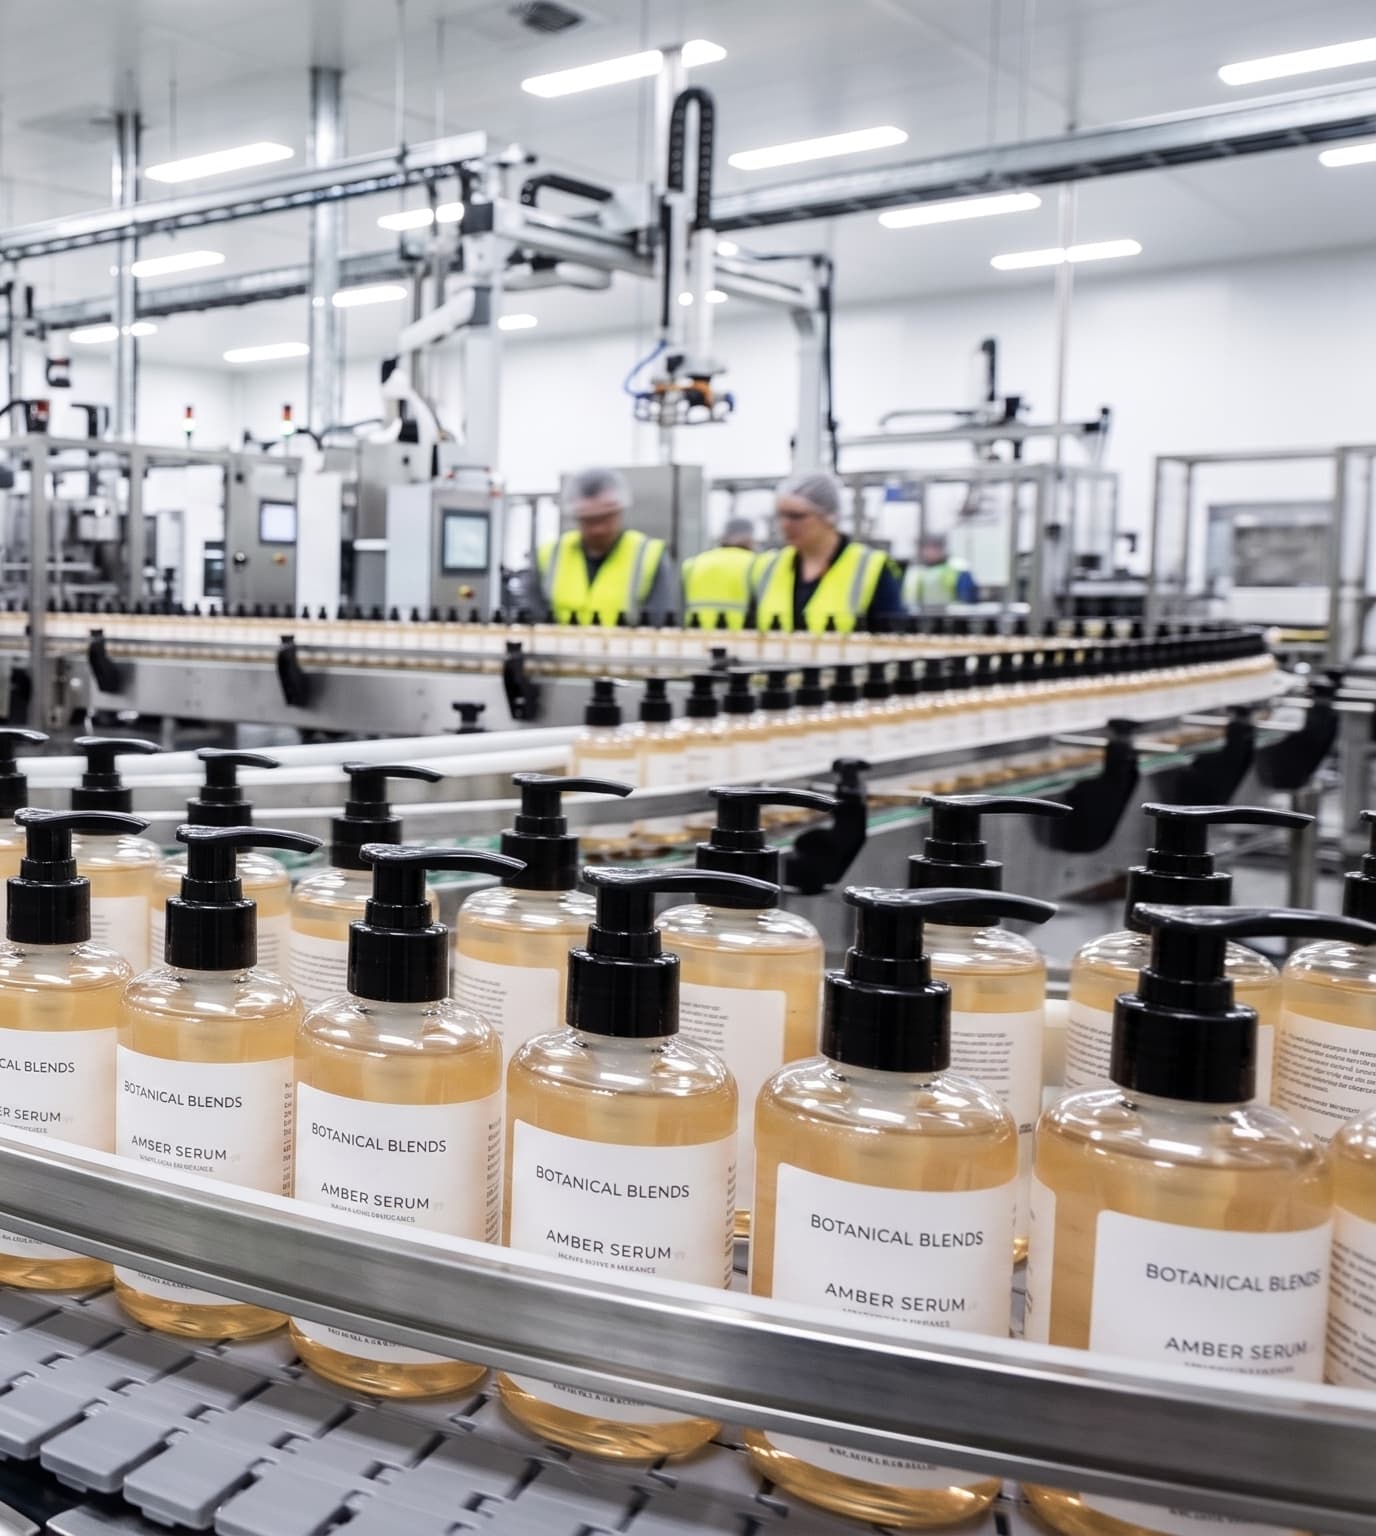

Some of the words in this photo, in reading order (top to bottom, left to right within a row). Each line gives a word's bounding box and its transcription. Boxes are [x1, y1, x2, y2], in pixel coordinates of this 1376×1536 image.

[24, 1061, 76, 1074] BLENDS
[124, 1080, 185, 1107] BOTANICAL
[188, 1095, 243, 1109] BLENDS
[14, 1108, 62, 1123] SERUM
[311, 1122, 384, 1151] BOTANICAL
[388, 1139, 447, 1154] BLENDS
[175, 1145, 227, 1161] SERUM
[321, 1182, 369, 1205] AMBER
[373, 1194, 430, 1210] SERUM
[536, 1165, 623, 1198] BOTANICAL
[627, 1184, 691, 1200] BLENDS
[546, 1229, 604, 1255] AMBER
[610, 1243, 672, 1260] SERUM
[810, 1214, 914, 1247] BOTANICAL
[919, 1231, 985, 1248] BLENDS
[1145, 1263, 1265, 1292] BOTANICAL
[1269, 1269, 1322, 1292] BLENDS
[824, 1282, 895, 1309] AMBER
[900, 1296, 966, 1313] SERUM
[1164, 1337, 1245, 1360] AMBER
[1250, 1341, 1309, 1361] SERUM
